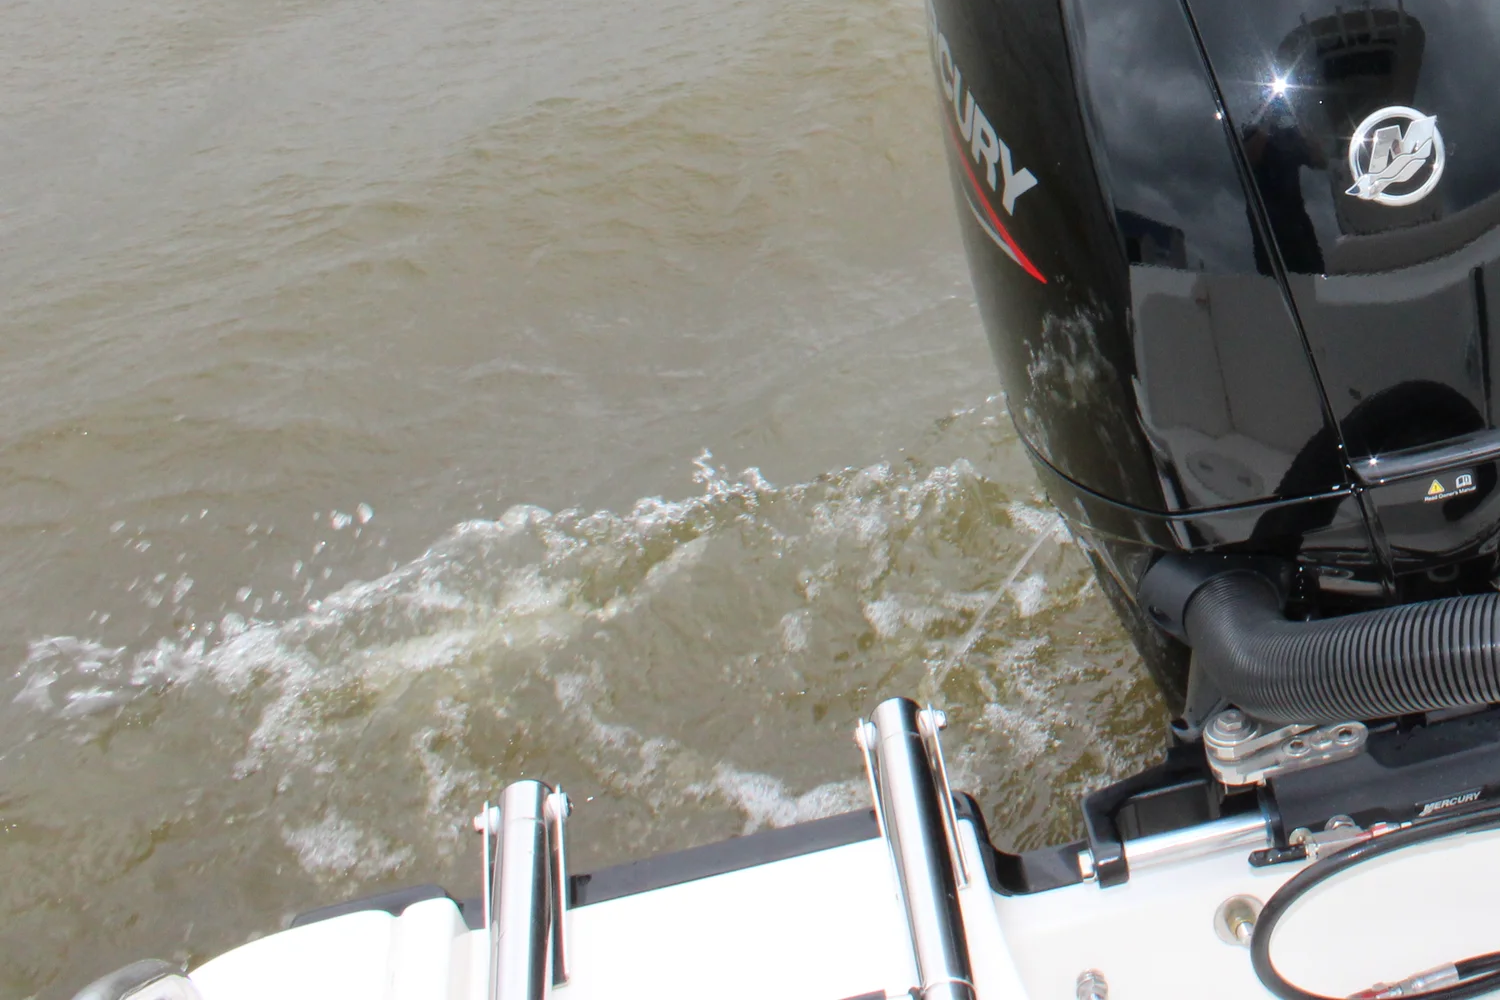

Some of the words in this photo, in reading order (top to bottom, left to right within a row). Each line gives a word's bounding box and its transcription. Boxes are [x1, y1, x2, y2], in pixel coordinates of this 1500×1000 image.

[1438, 490, 1459, 499] Owner's
[1459, 484, 1477, 494] Manual
[1419, 791, 1481, 817] MERCURY
